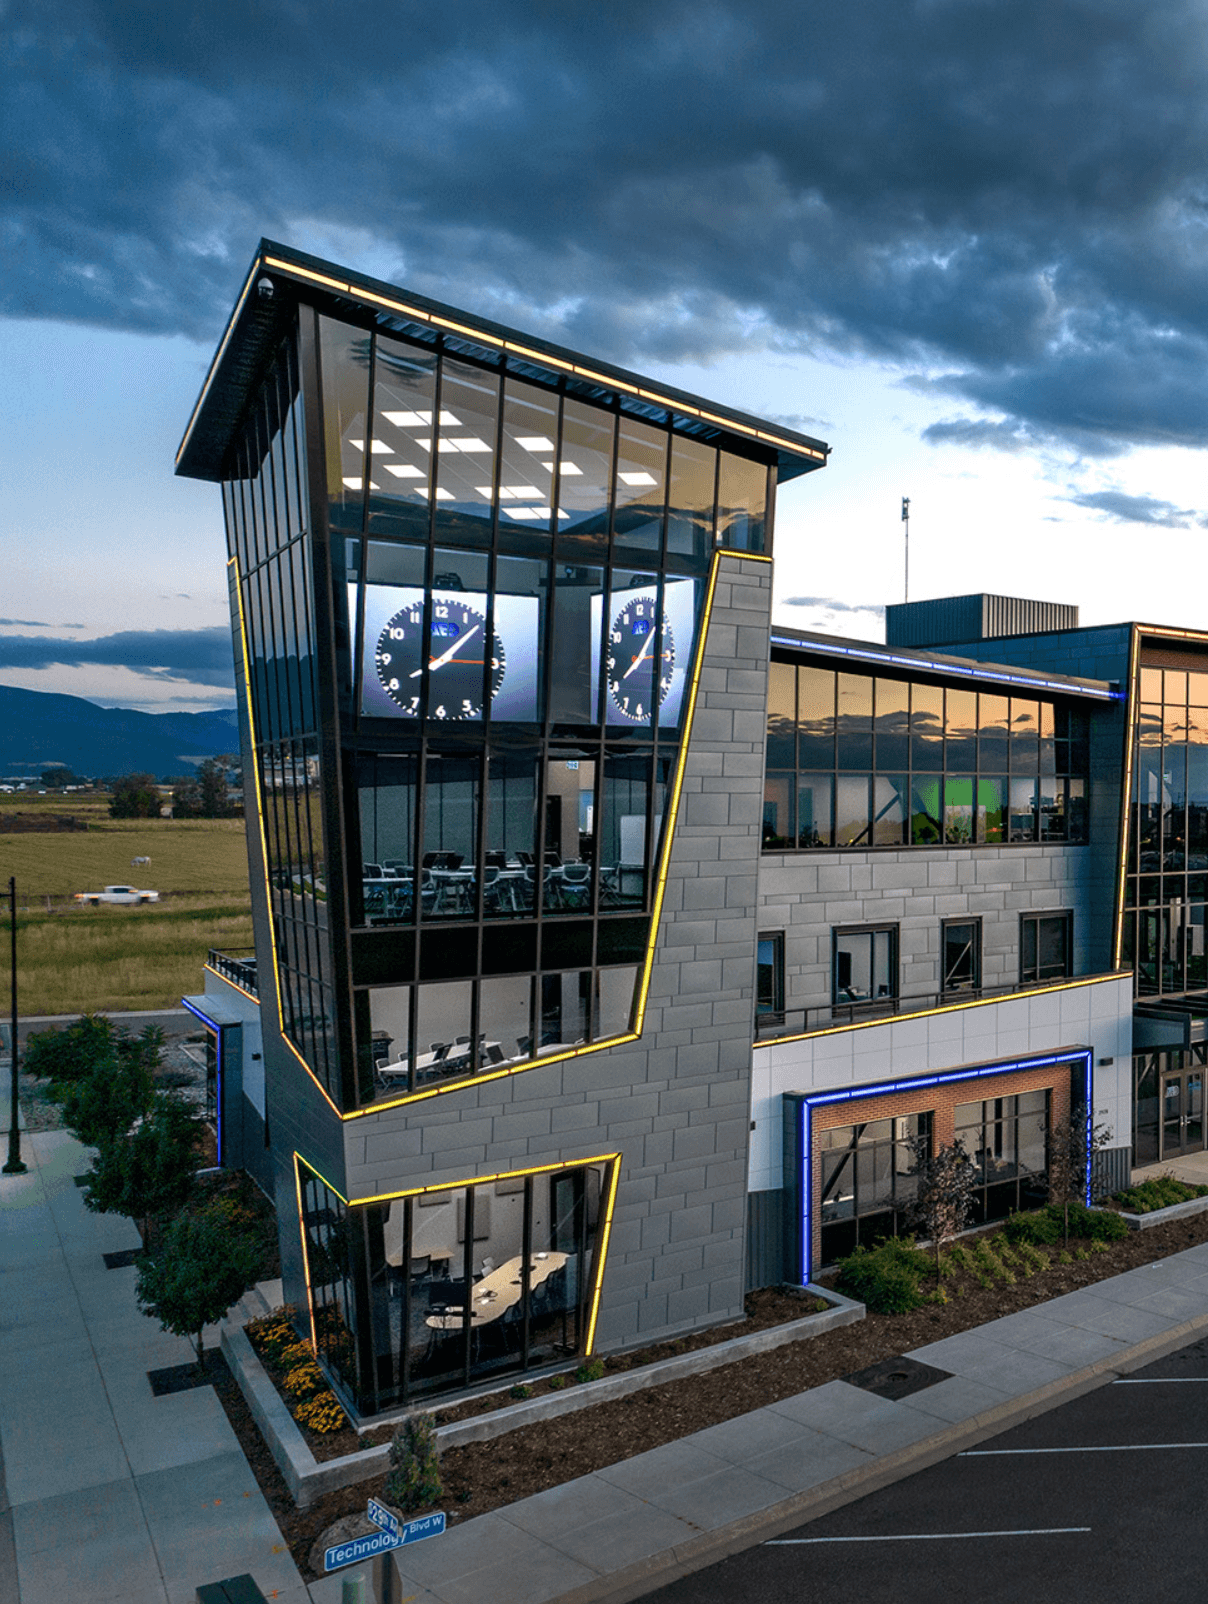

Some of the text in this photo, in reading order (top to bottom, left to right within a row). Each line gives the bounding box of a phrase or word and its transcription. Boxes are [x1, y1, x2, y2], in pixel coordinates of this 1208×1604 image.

[435, 606, 449, 618] 12
[636, 604, 644, 616] 12
[410, 611, 420, 624] 11
[463, 612, 468, 624] 1
[389, 627, 405, 640] 10
[612, 631, 622, 644] 10
[381, 653, 392, 666] 9
[490, 658, 500, 670] 3
[388, 678, 400, 690] 8
[410, 696, 420, 709] 7
[461, 699, 472, 712] 5
[623, 697, 629, 709] 7
[435, 705, 446, 718] 6
[410, 1519, 430, 1534] Blvd
[432, 1515, 443, 1527] W
